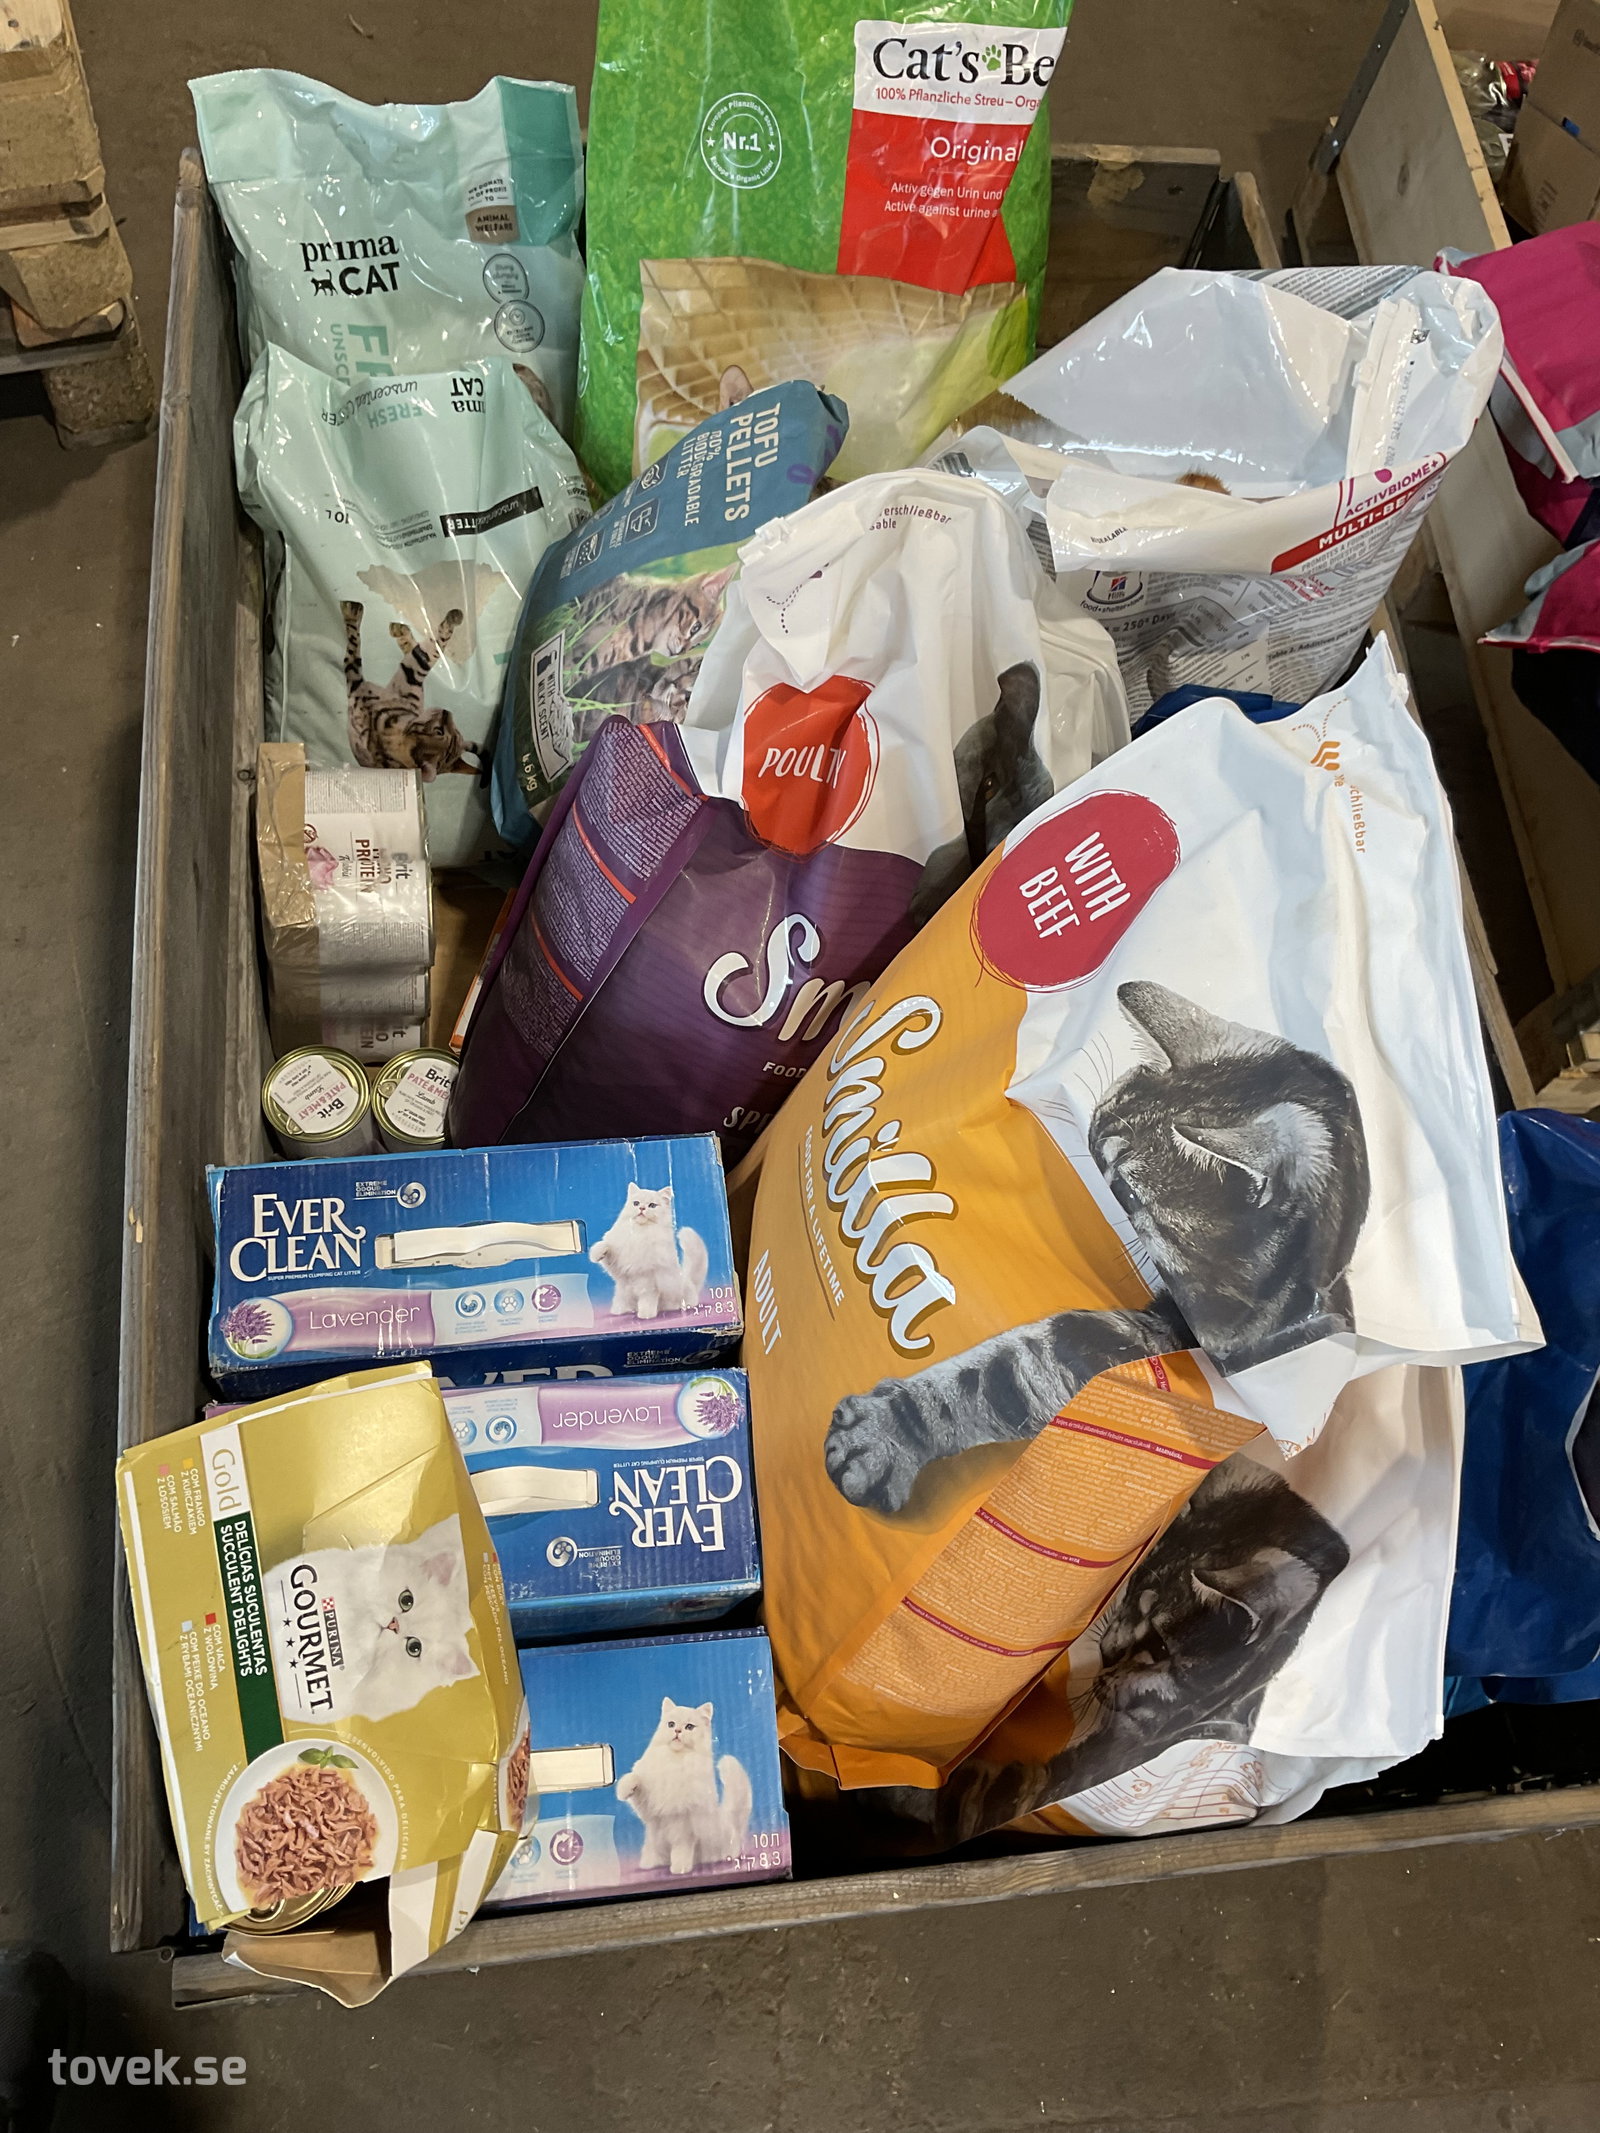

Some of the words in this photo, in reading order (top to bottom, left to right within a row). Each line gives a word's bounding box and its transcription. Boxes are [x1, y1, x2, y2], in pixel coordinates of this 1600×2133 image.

[872, 37, 979, 84] Cat's
[1001, 43, 1055, 87] Be
[875, 87, 906, 101] 100%
[909, 88, 971, 105] Pflanzliche
[974, 93, 1004, 107] Streu
[723, 131, 761, 152] Nr.1
[930, 136, 1025, 166] Original
[890, 181, 917, 194] Aktiv
[919, 185, 953, 199] gegen
[957, 185, 979, 200] Urin
[982, 188, 1002, 200] und
[476, 213, 510, 223] ANIMAL
[884, 199, 916, 213] Active
[918, 202, 960, 217] against
[963, 206, 990, 218] urine
[475, 222, 514, 232] WELFARE
[300, 235, 400, 272] prima
[338, 261, 400, 296] CAT
[450, 376, 484, 397] CAT
[367, 402, 423, 429] FRESH
[754, 402, 781, 468] TOFU
[676, 437, 696, 479] LITTER
[724, 412, 753, 522] PELLETS
[685, 432, 710, 527] BIODEGRADABLE
[1344, 459, 1439, 520] ACTIVBIOME+
[448, 518, 477, 530] TTER
[880, 504, 952, 525] erschließbar
[537, 678, 546, 708] MILKY
[547, 671, 556, 699] WITH
[538, 708, 550, 742] SCENT
[526, 775, 538, 792] kg
[758, 743, 847, 789] POULTY
[355, 839, 376, 893] PROTEIN
[1065, 831, 1131, 922] WITH
[1019, 866, 1081, 939] BEEF
[425, 1068, 451, 1088] Brit
[317, 1098, 345, 1119] Brit
[805, 1125, 814, 1168] FOOD
[805, 1169, 814, 1204] FOR
[822, 995, 957, 1358] Smilla
[252, 1192, 367, 1240] EVER
[808, 1203, 816, 1219] A
[229, 1232, 362, 1282] CLEAN
[812, 1218, 845, 1307] LIFETIME
[309, 1304, 420, 1330] Lavender
[714, 1302, 735, 1314] 8.3
[753, 1248, 782, 1355] ADULT
[553, 1404, 662, 1429] Lavender
[166, 1474, 176, 1495] COM
[190, 1468, 200, 1489] COM
[212, 1448, 242, 1512] Gold
[613, 1455, 743, 1508] CLEAN
[158, 1485, 172, 1530] ŁOSOSIEM
[169, 1496, 183, 1533] SALMÃO
[182, 1478, 197, 1535] KURCZAKIEM
[194, 1489, 206, 1527] FRANGO
[608, 1500, 726, 1552] EVER
[220, 1524, 243, 1604] SUCCULENT
[232, 1608, 253, 1677] DELIGHTS
[234, 1520, 254, 1583] DELÍCIAS
[244, 1584, 268, 1676] SUCULENTAS
[189, 1631, 199, 1653] COM
[213, 1624, 223, 1646] COM
[290, 1564, 334, 1712] GOURMET
[324, 1611, 340, 1666] PURINA
[180, 1642, 192, 1678] RYBAMI
[191, 1653, 203, 1681] PEIXE
[215, 1646, 226, 1673] VACA
[195, 1682, 205, 1697] DO
[185, 1679, 203, 1752] OCEANICZNYMI
[198, 1699, 211, 1741] OCEANO
[204, 1764, 239, 1840] ZAPROJEKTOWANE
[393, 1783, 405, 1808] PARA
[203, 1842, 211, 1856] BY
[759, 1851, 782, 1869] 8.3
